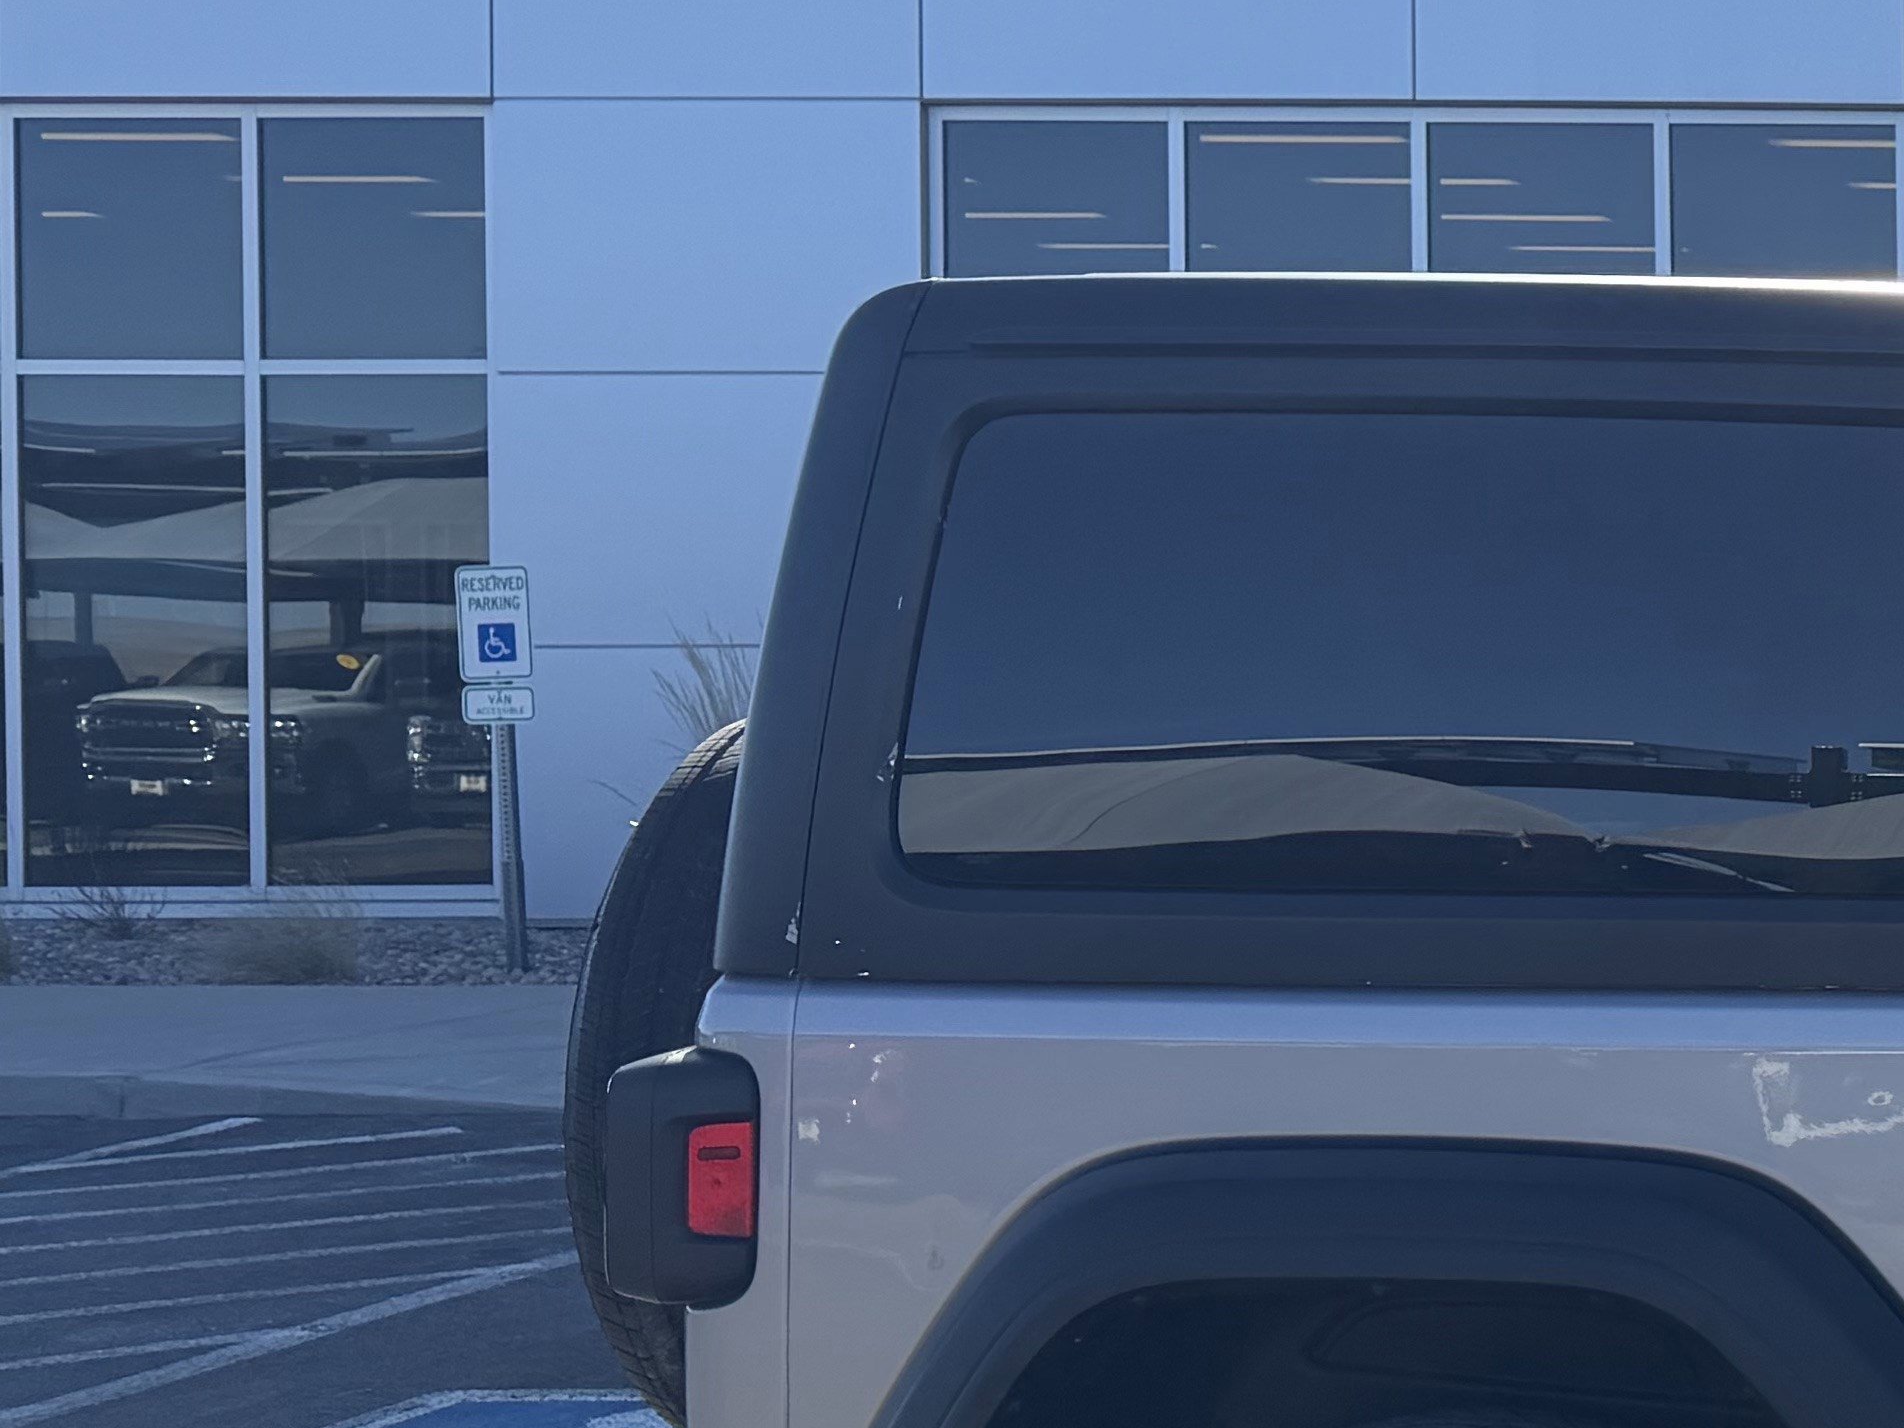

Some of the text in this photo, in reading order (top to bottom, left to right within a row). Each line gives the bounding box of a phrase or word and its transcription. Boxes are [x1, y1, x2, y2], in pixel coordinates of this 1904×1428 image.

[461, 575, 524, 593] RESERVED
[468, 596, 521, 612] PARKING
[487, 694, 512, 705] VAN
